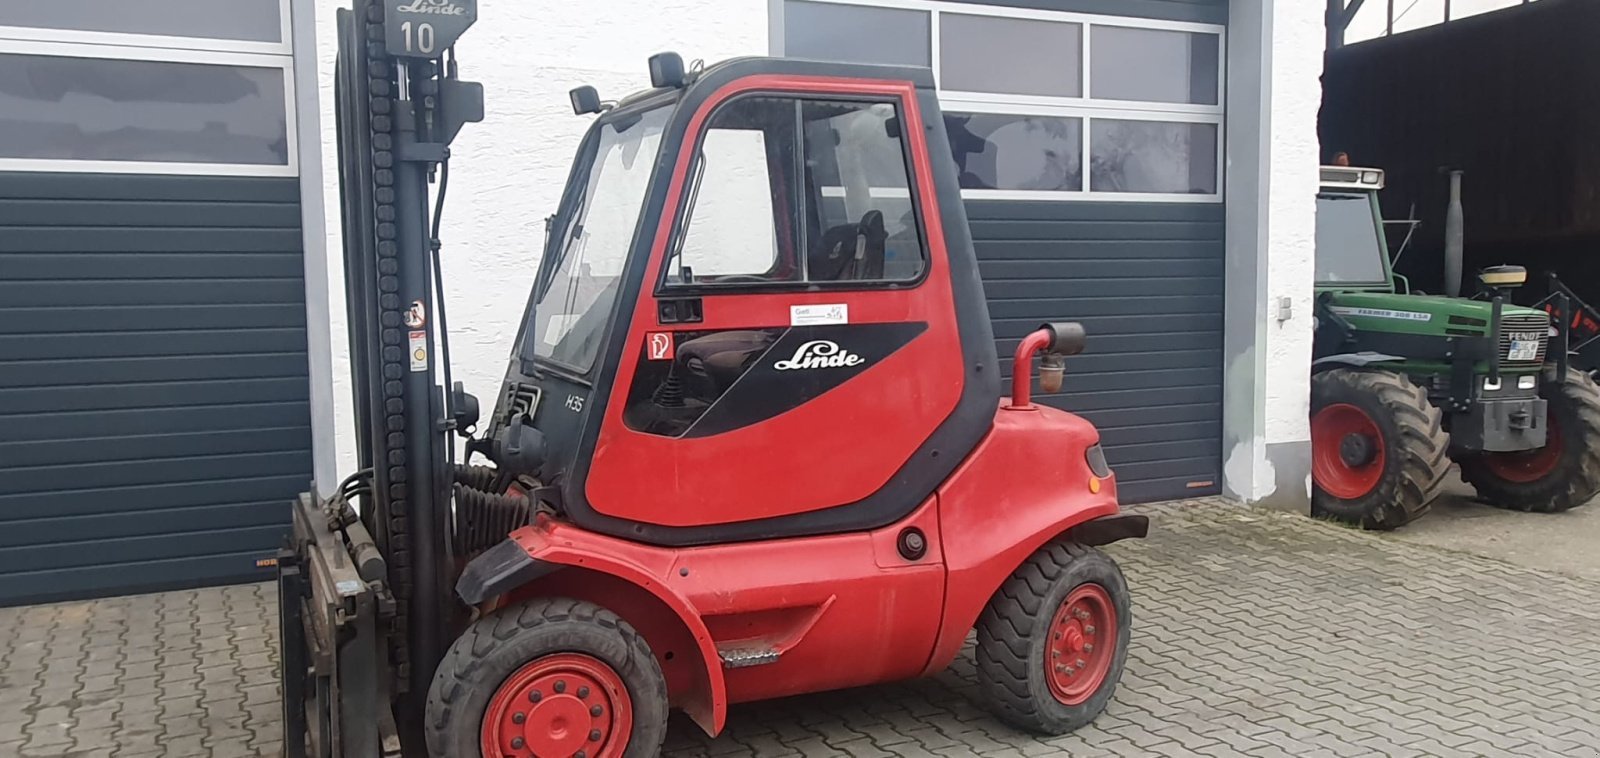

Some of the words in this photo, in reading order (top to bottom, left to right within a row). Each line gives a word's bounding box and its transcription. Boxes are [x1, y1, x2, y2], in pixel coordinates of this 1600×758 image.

[396, 0, 465, 15] Linde
[401, 21, 434, 53] 10
[1358, 308, 1392, 317] FARMER
[1509, 332, 1541, 341] FENDT
[774, 340, 865, 370] Linde
[565, 394, 584, 412] H35
